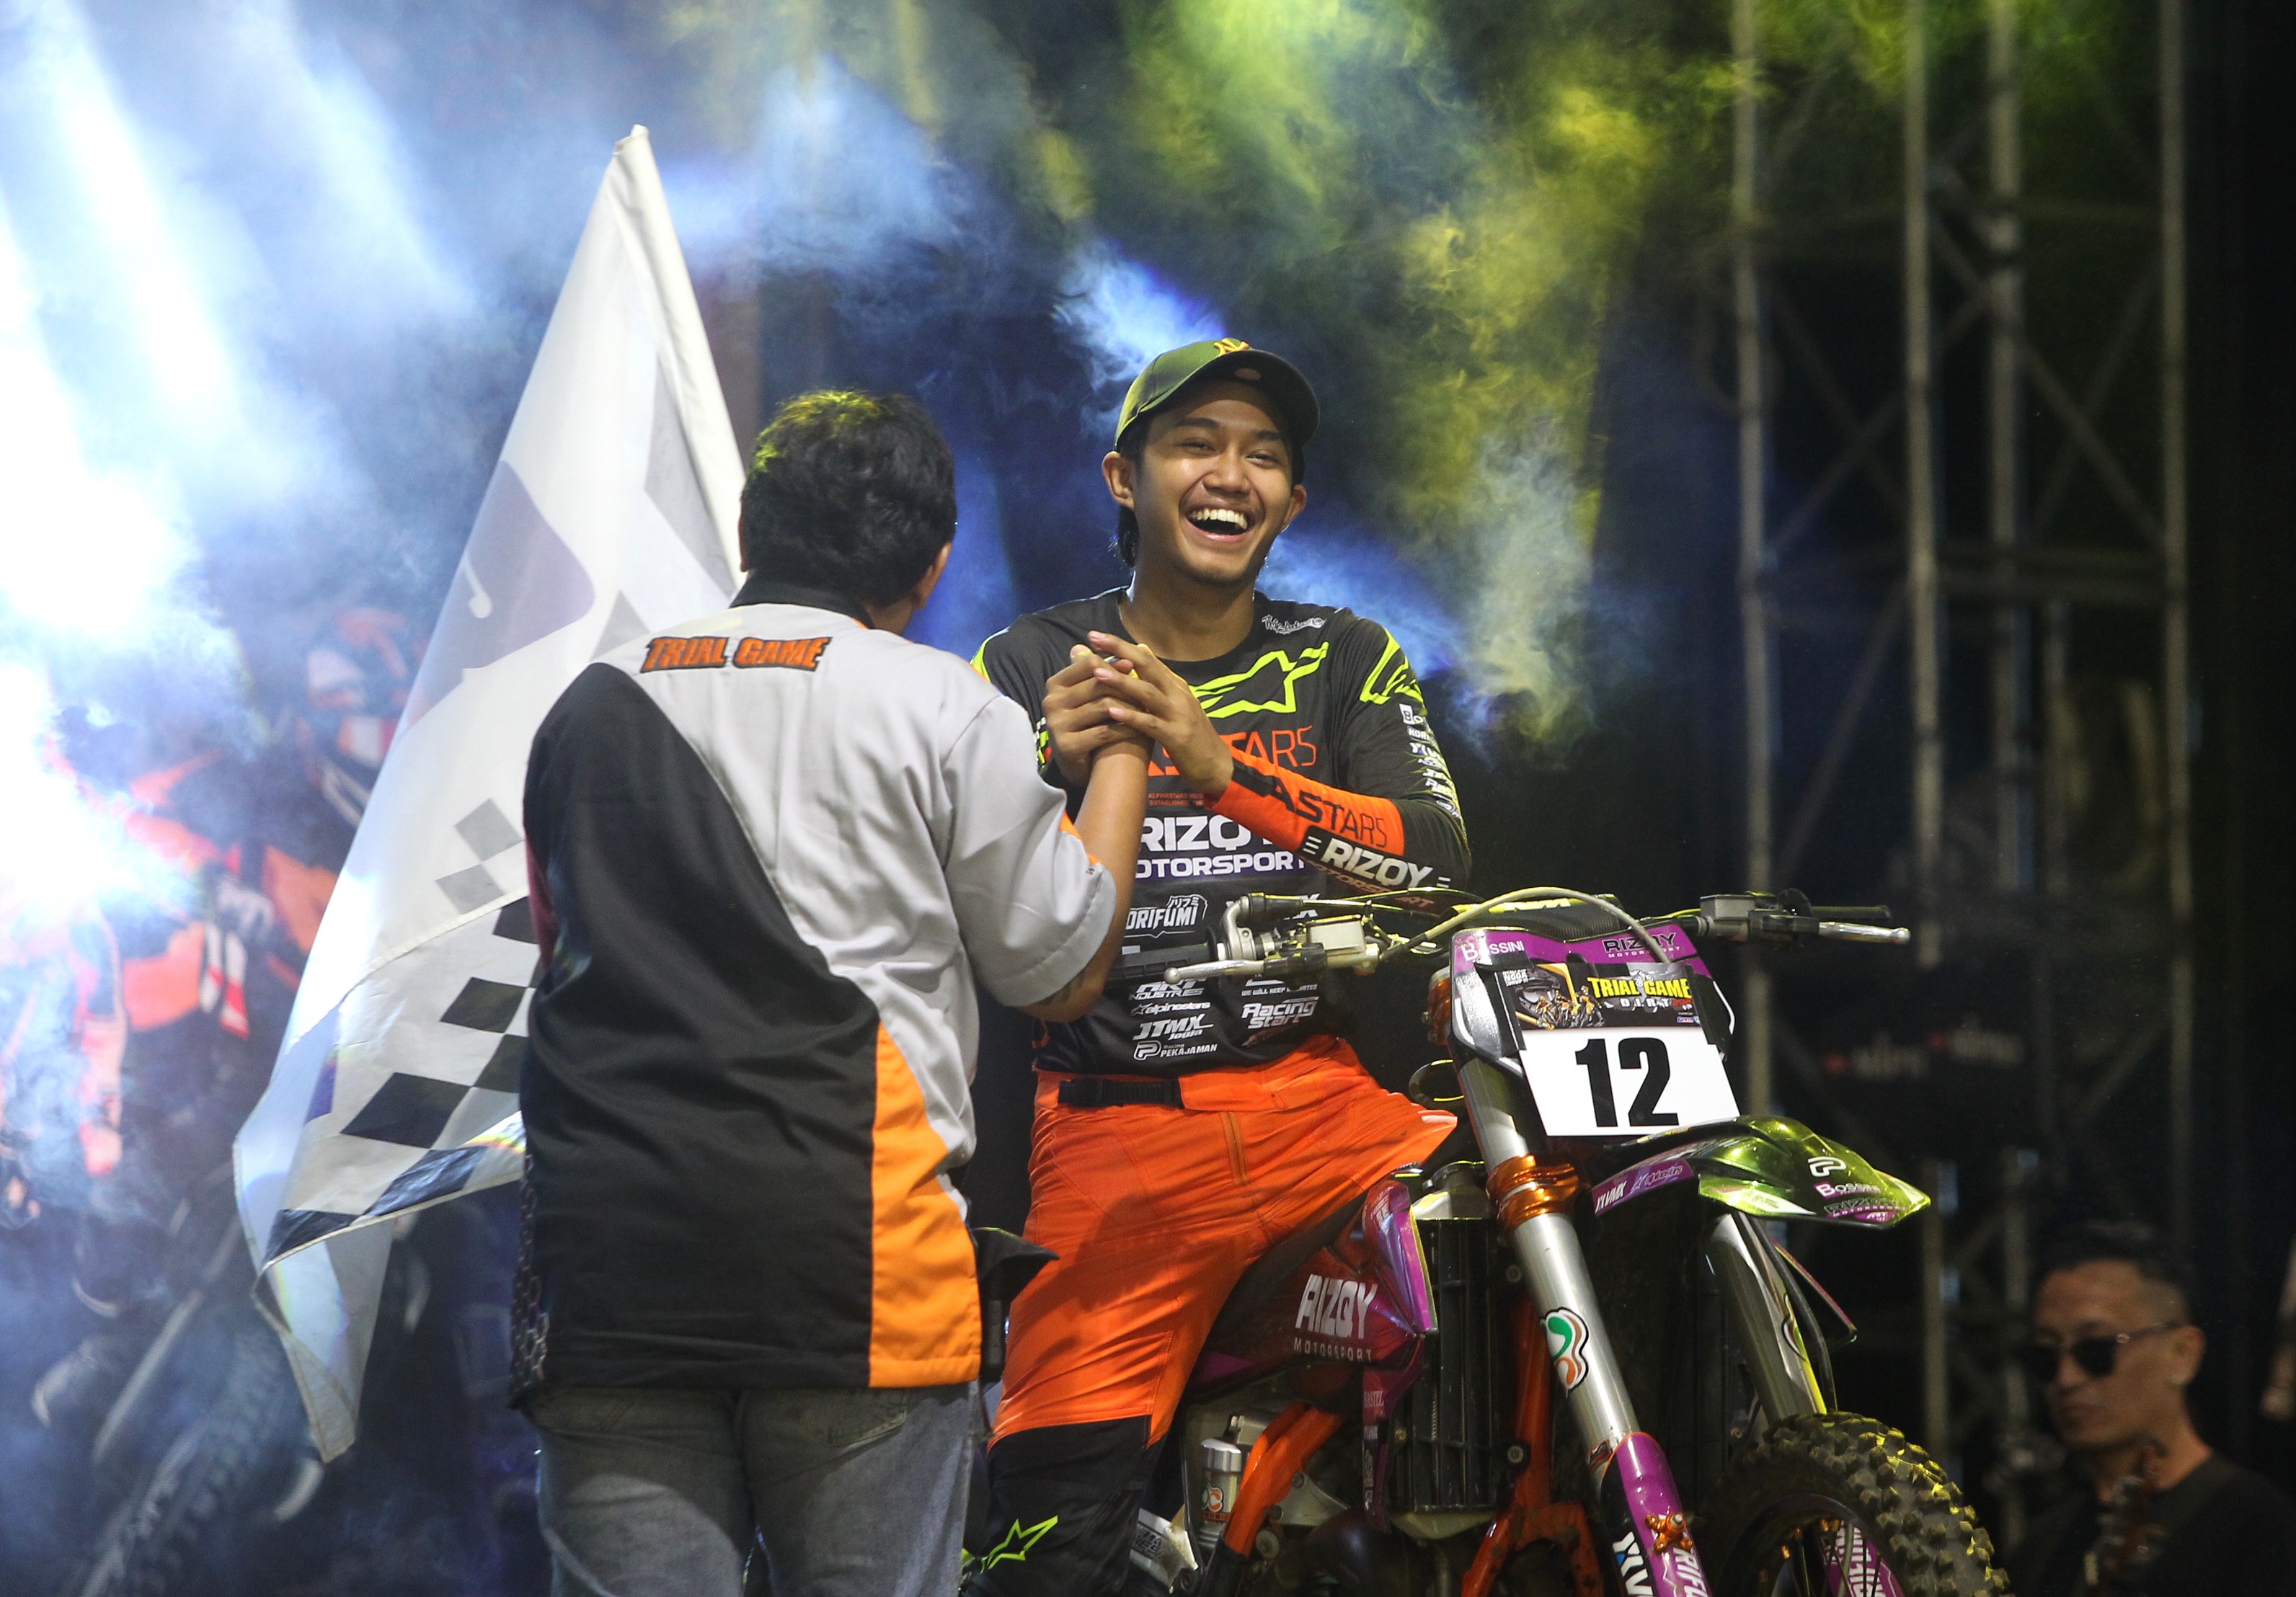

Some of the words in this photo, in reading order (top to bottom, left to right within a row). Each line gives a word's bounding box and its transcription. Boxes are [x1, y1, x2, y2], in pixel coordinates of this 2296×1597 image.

[640, 636, 729, 672] TRIAL
[732, 636, 832, 672] GAME
[1134, 850, 1305, 878] OTORSPOR
[1125, 907, 1199, 930] ORIFUMI
[1461, 940, 1525, 962] BSSINI
[1602, 933, 1676, 953] RIZY
[1587, 977, 1640, 999] TRIAL
[1643, 978, 1692, 999] GAME
[1241, 1001, 1318, 1018] Racing
[1133, 1013, 1214, 1040] JTMX
[1160, 1044, 1218, 1057] PEKAJAMAN
[1575, 1037, 1680, 1127] 12
[1293, 1338, 1372, 1362] MOTORSPORT
